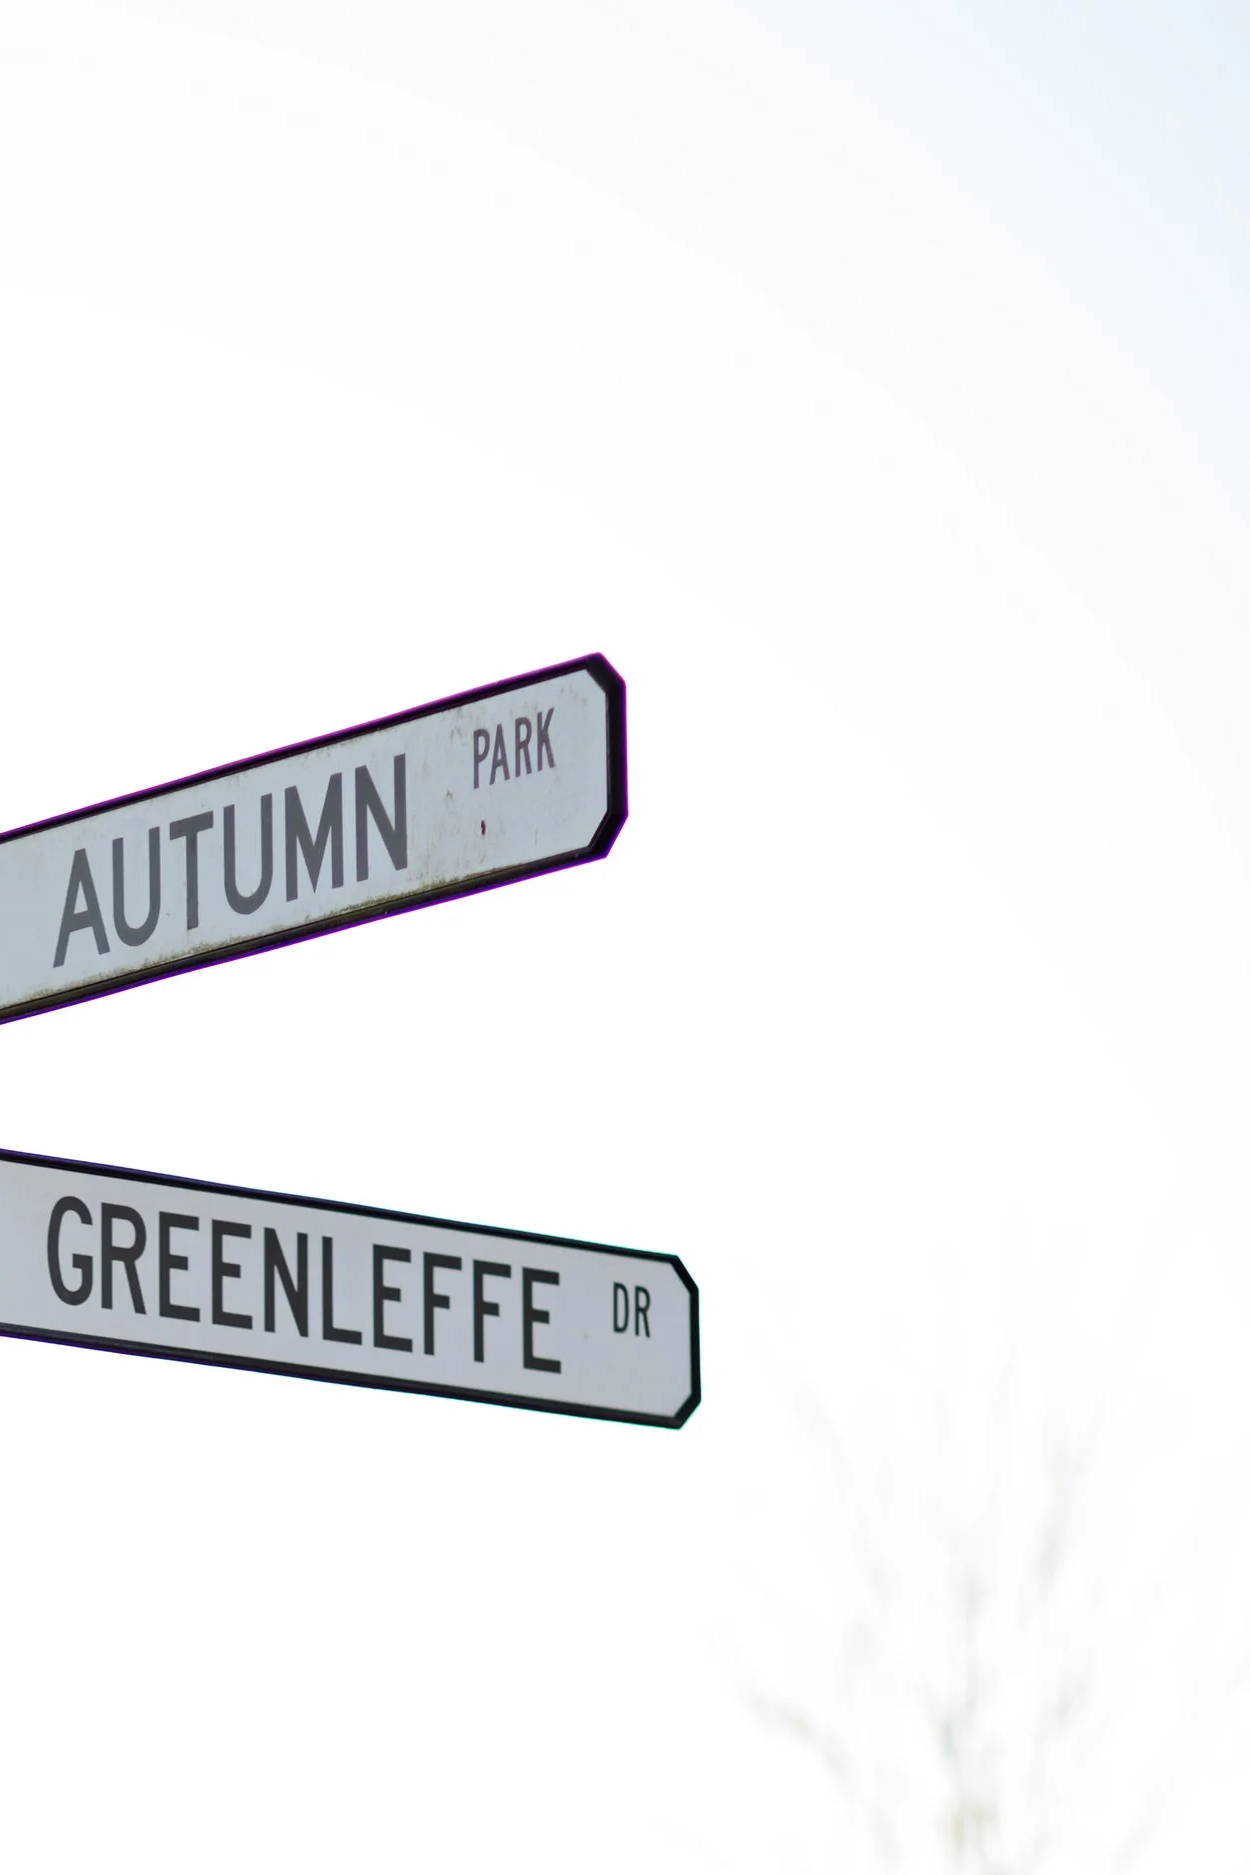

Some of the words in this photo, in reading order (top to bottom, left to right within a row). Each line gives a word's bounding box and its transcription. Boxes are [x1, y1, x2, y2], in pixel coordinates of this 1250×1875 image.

[52, 754, 409, 968] AUTUMN
[472, 708, 556, 790] PARK
[46, 1195, 562, 1374] GREENLEFFE
[612, 1282, 652, 1338] DR
